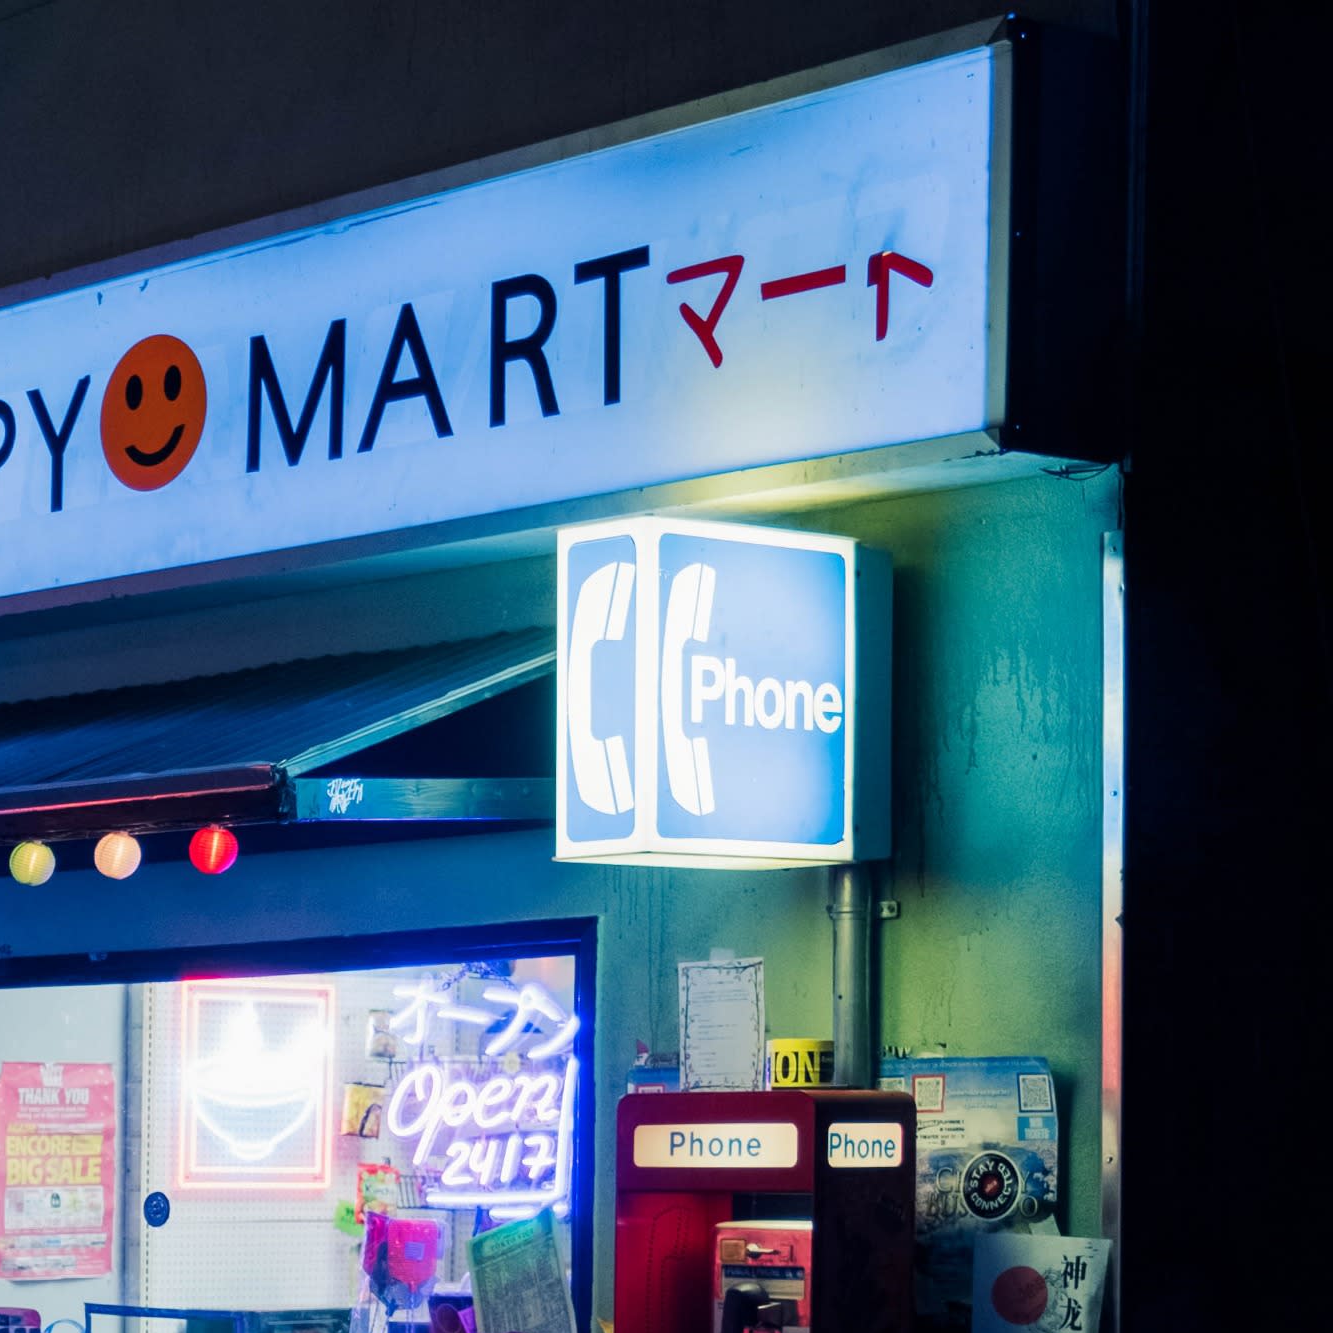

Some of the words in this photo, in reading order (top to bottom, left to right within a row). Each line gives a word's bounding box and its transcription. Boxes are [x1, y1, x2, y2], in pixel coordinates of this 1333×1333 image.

[245, 245, 650, 472] MART
[691, 655, 843, 733] Phone
[17, 1088, 60, 1106] THANK
[64, 1087, 90, 1105] YOU
[388, 1063, 561, 1166] Open
[442, 1132, 555, 1186] 24/7
[669, 1131, 761, 1158] Phone
[829, 1133, 896, 1160] Phone
[6, 1158, 43, 1185] BIG
[44, 1156, 102, 1184] SALE
[969, 1160, 995, 1189] STAY
[1059, 1255, 1087, 1331] 神龙
